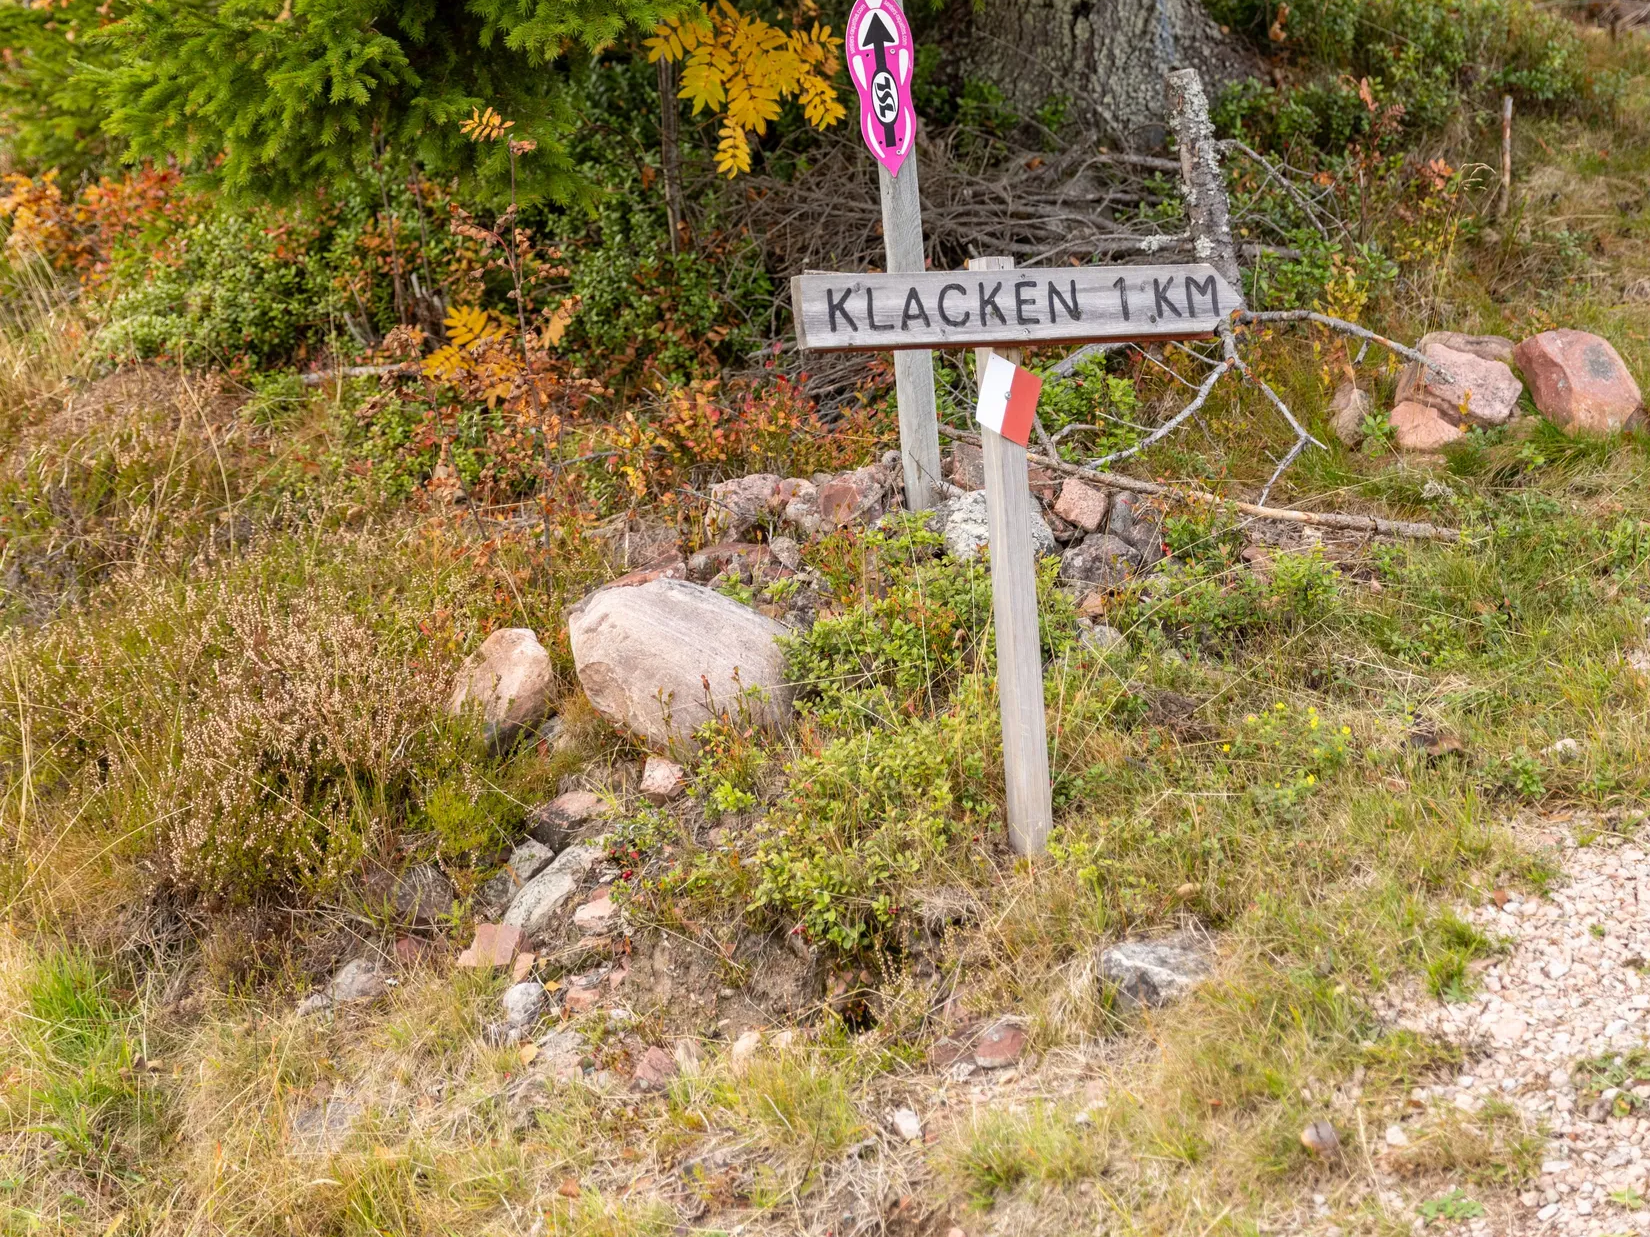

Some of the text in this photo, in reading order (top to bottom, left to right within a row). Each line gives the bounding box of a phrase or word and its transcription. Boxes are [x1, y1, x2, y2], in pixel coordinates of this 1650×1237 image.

[826, 275, 1220, 333] KLACKEN 1 KM
